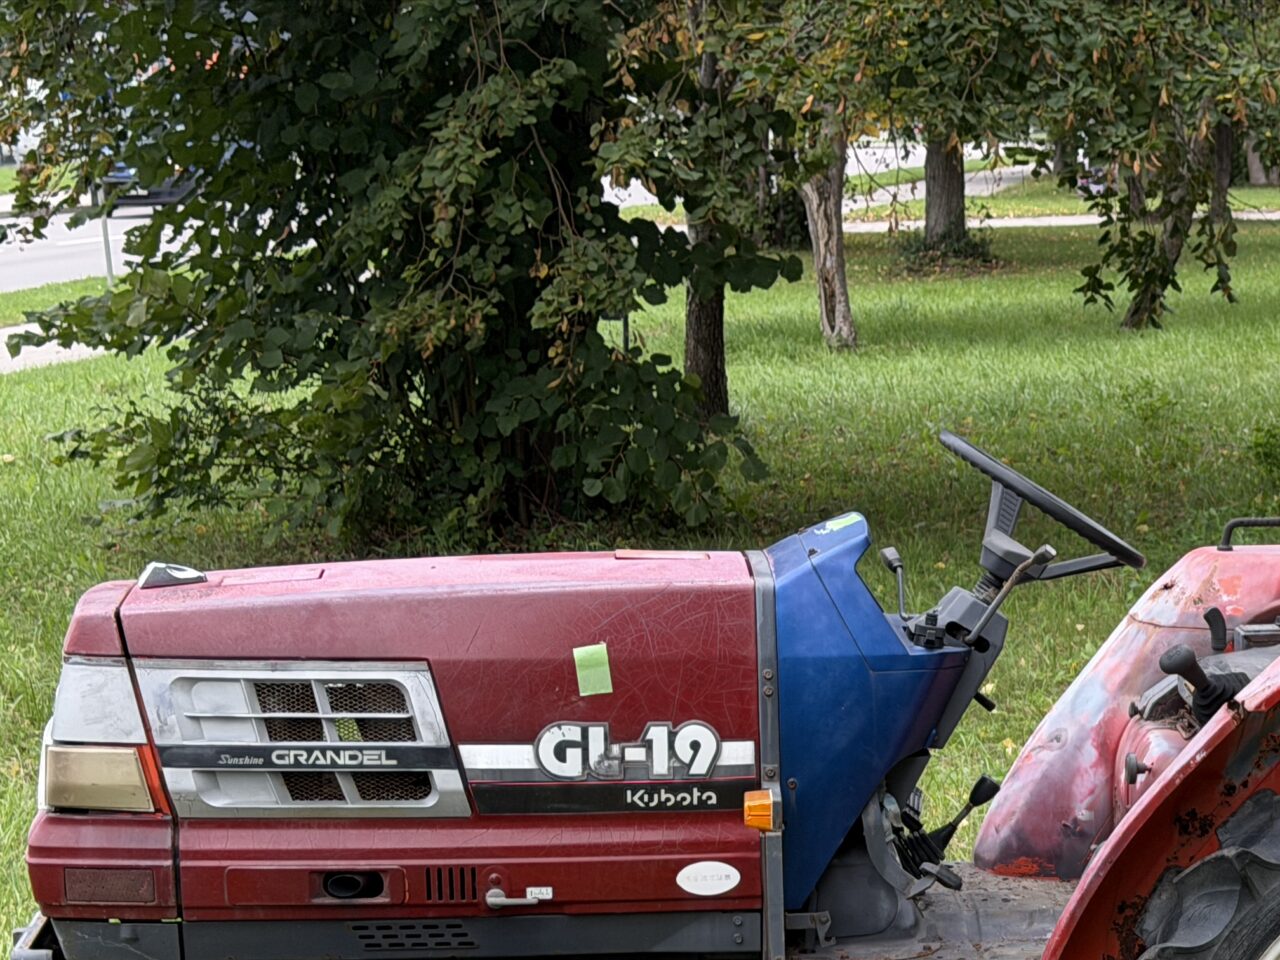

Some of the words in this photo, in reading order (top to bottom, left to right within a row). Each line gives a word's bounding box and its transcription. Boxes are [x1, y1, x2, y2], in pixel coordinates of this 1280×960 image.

[217, 753, 265, 766] Sunshine
[270, 749, 398, 766] GRANDEL
[537, 722, 719, 779] GL-19
[625, 786, 718, 808] Kubota
